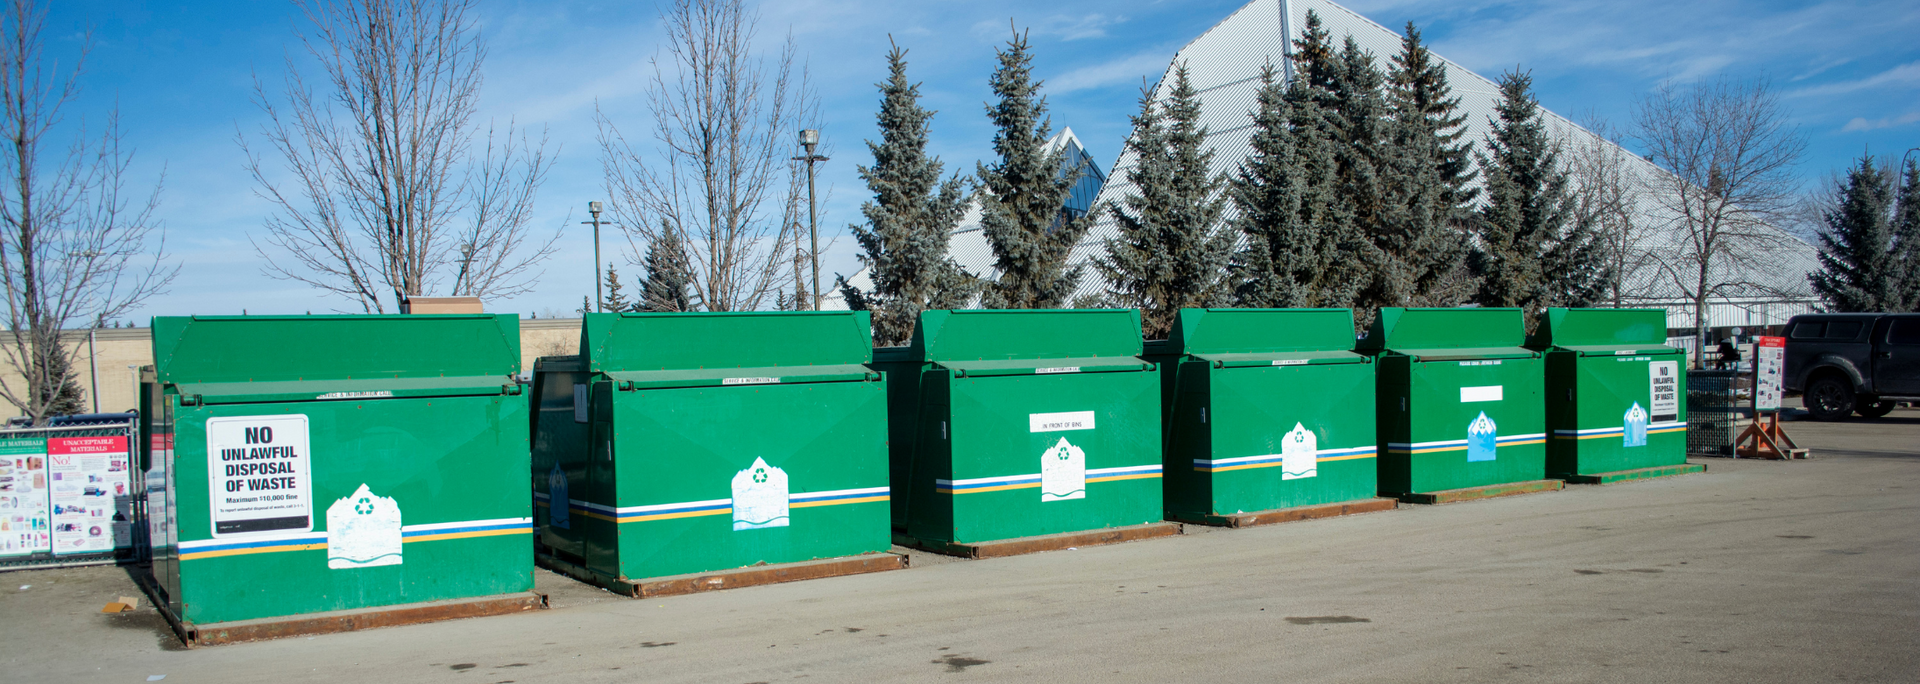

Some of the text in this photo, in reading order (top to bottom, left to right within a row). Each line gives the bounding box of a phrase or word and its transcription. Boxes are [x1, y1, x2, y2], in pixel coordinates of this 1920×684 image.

[1659, 366, 1668, 376] NO
[245, 426, 273, 444] NO
[52, 456, 71, 466] No!
[221, 446, 298, 461] UNLAWFUL
[225, 461, 295, 477] DISPOSAL
[226, 476, 296, 492] OF WASTE
